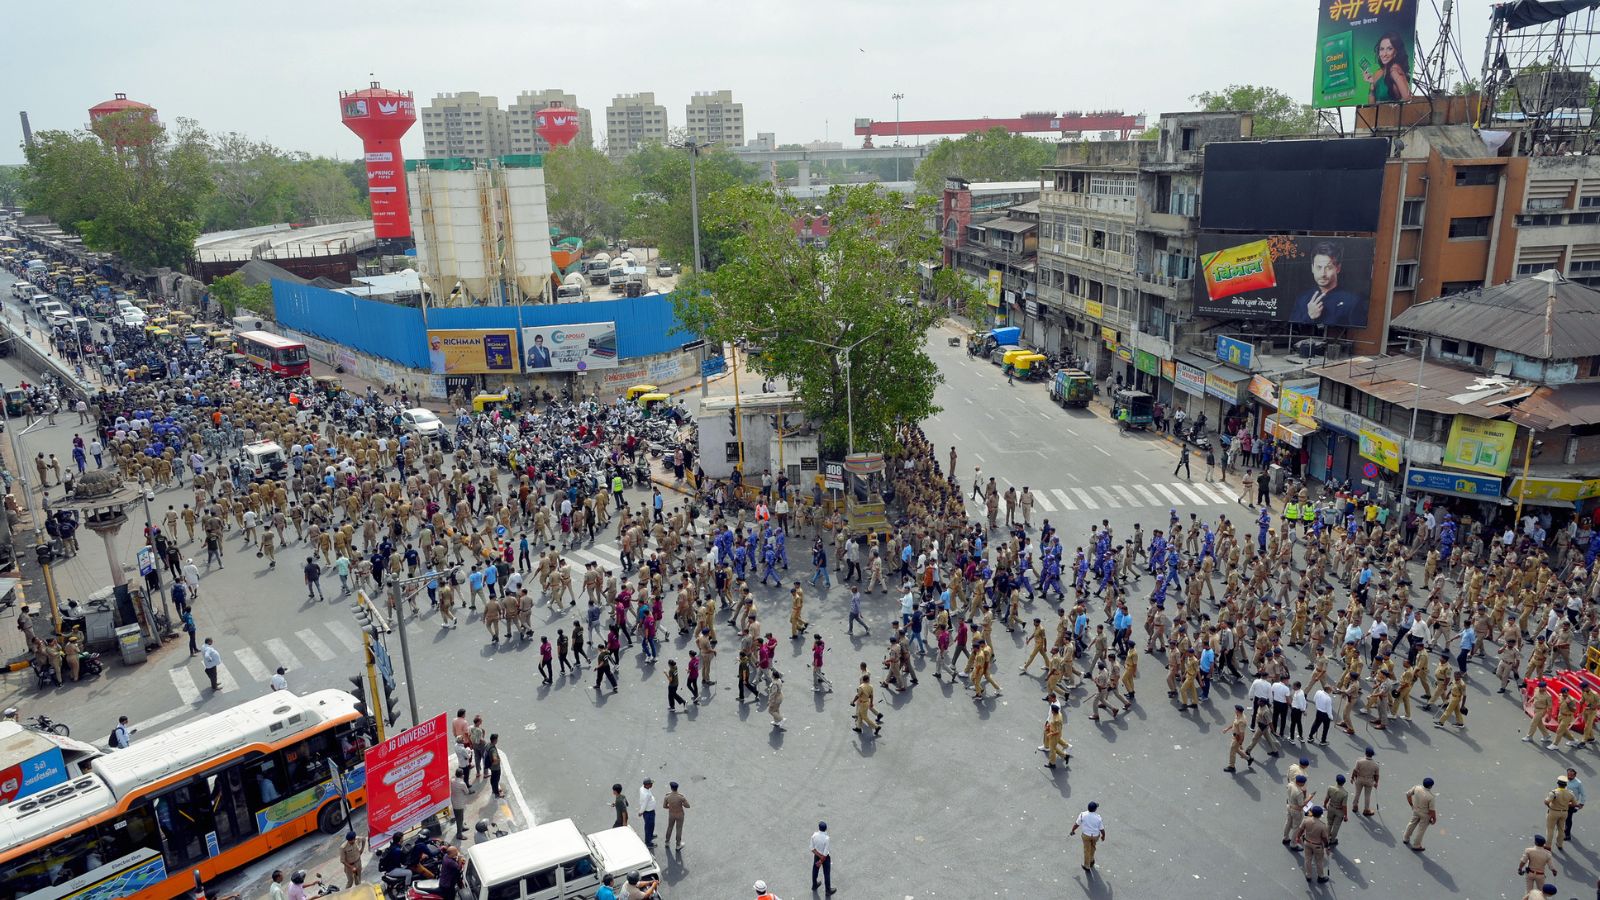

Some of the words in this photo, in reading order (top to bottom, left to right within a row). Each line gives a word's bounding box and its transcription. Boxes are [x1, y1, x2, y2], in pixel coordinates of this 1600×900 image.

[1326, 53, 1344, 63] Chaini
[1329, 61, 1347, 72] Chaini
[443, 338, 481, 346] RICHMAN
[388, 739, 396, 753] JG
[397, 720, 436, 748] UNIVERSITY
